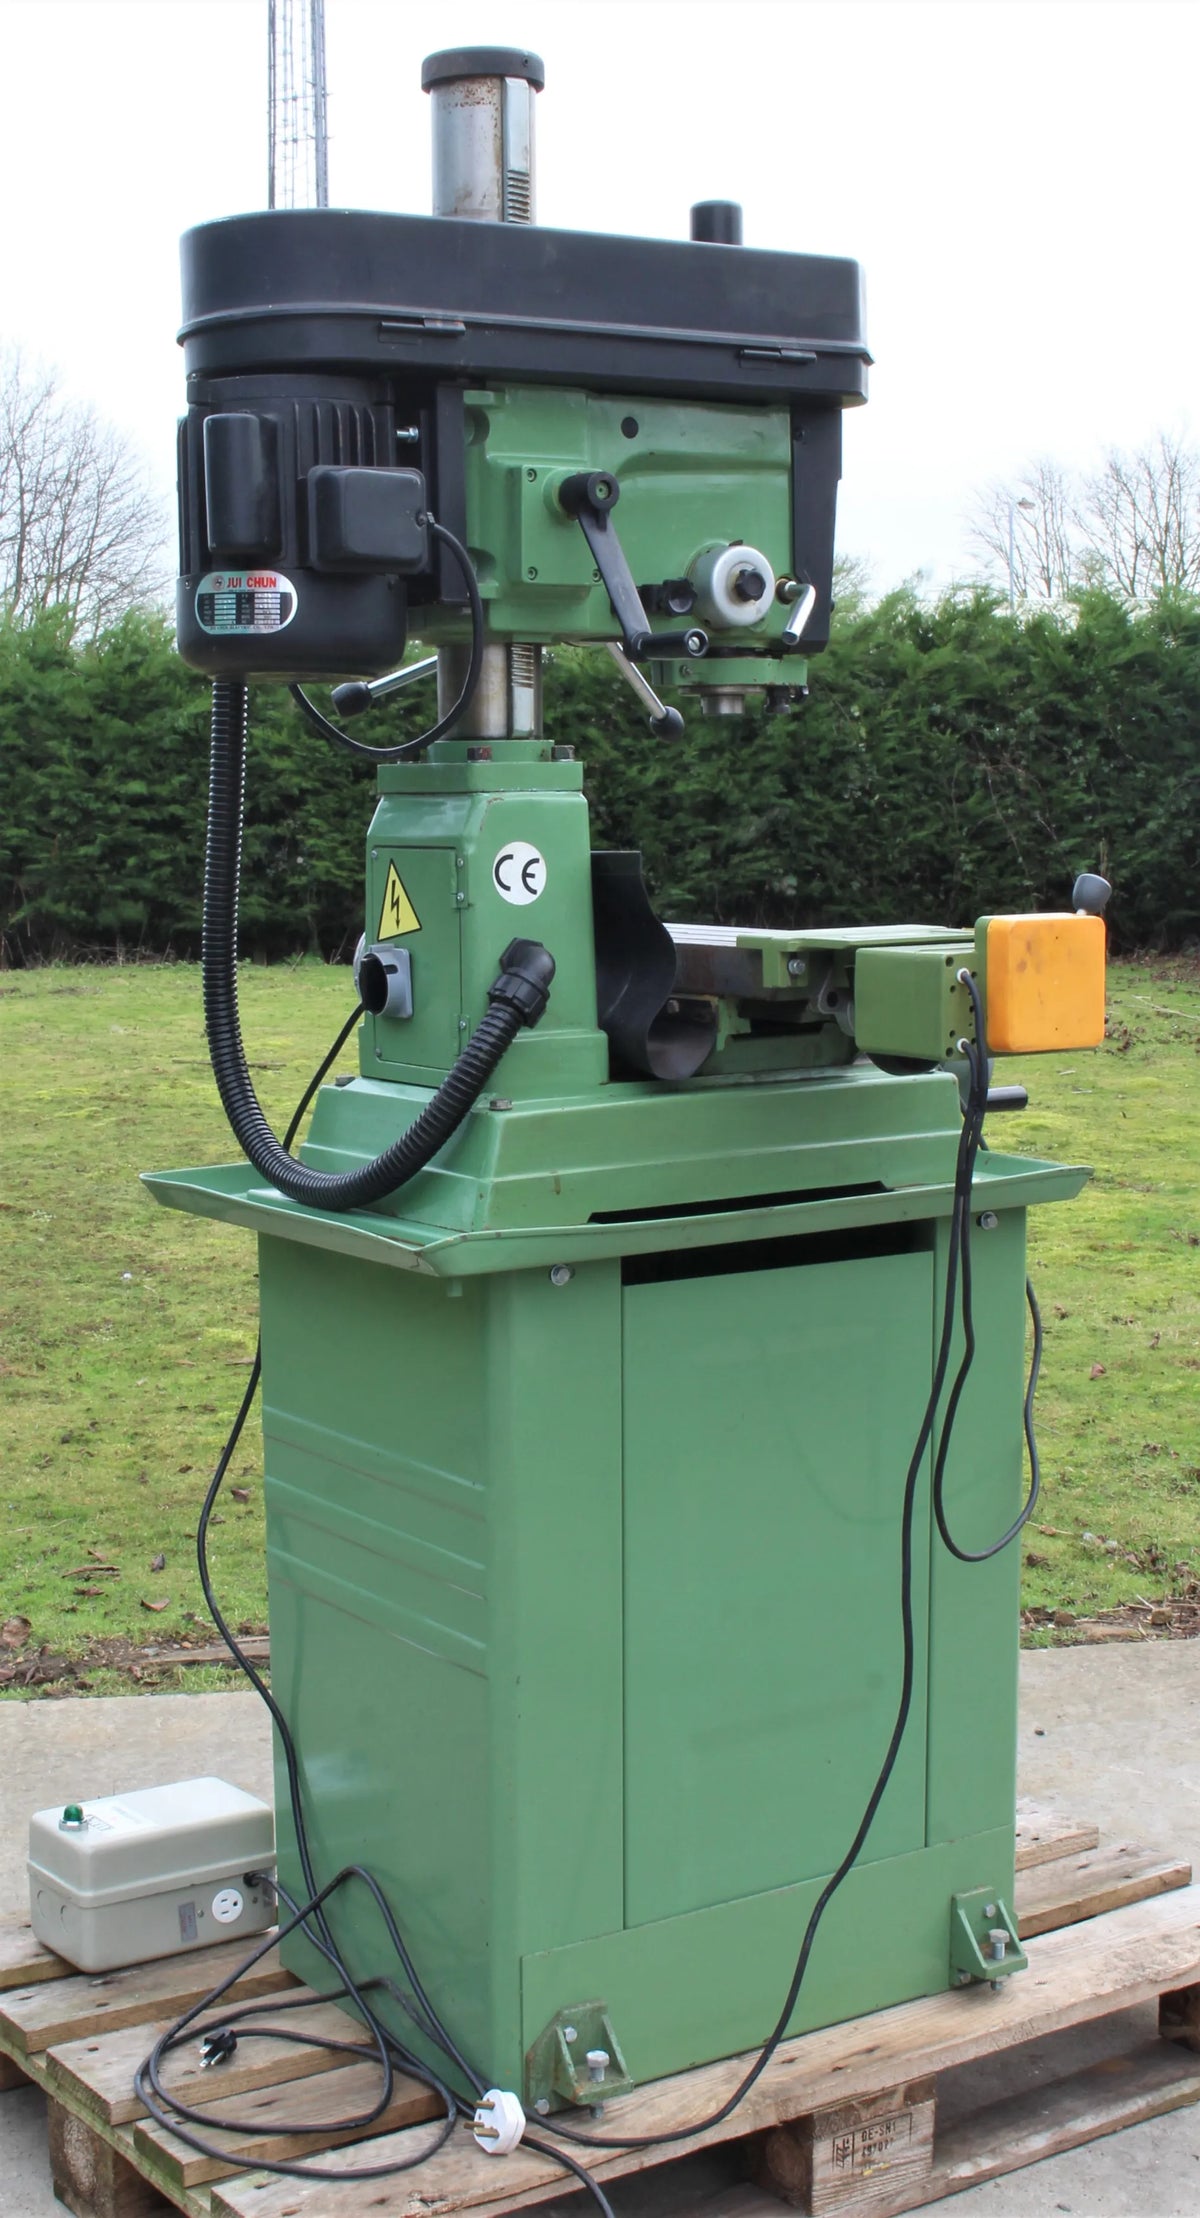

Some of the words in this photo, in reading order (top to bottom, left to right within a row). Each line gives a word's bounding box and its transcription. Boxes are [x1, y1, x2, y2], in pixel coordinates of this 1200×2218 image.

[227, 576, 242, 588] JUI
[246, 576, 277, 588] CHUN
[494, 853, 540, 895] CE
